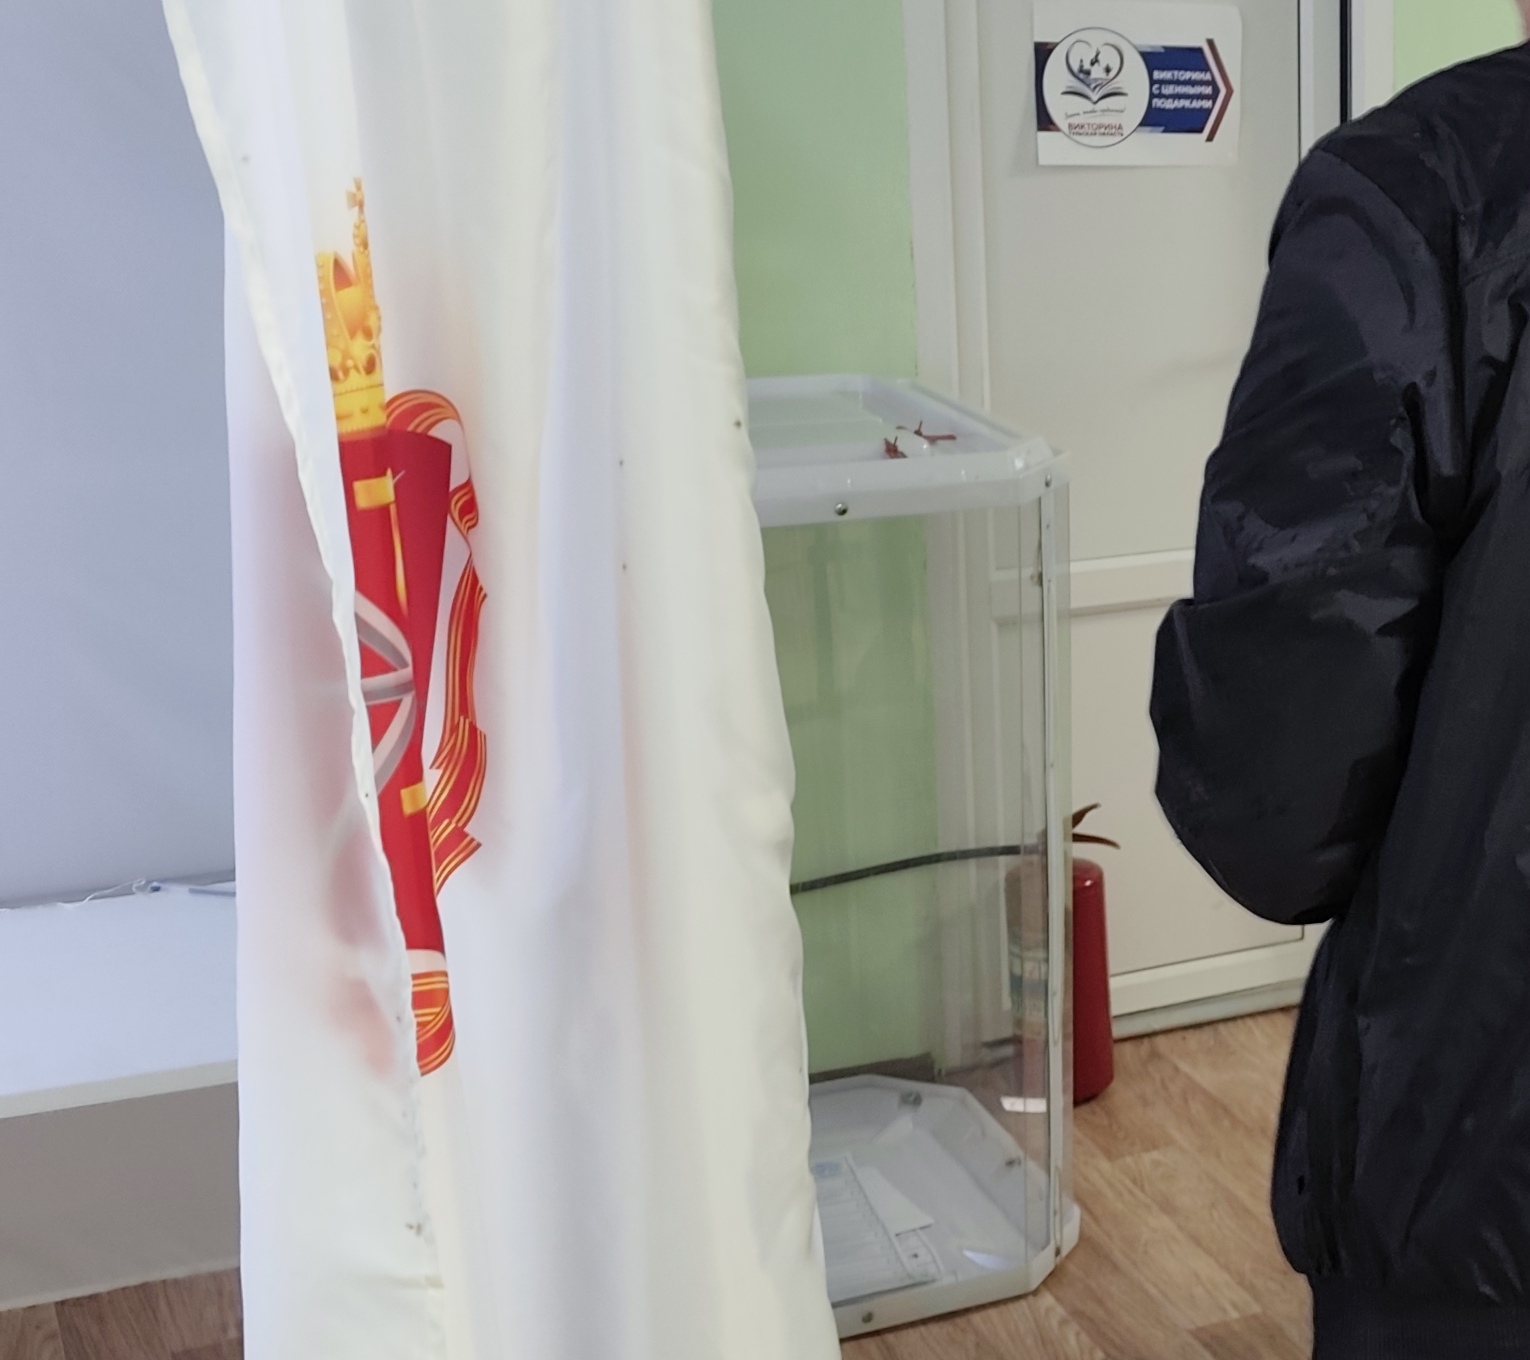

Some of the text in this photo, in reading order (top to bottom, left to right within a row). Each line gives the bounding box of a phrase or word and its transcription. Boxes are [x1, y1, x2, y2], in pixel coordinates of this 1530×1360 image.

[1153, 70, 1213, 81] ВИКТОРИНА
[1152, 83, 1213, 96] С ЦЕННЫМИ
[1152, 98, 1213, 110] ПОДАРКАМИ
[1068, 122, 1124, 131] ВИКТОРИНА
